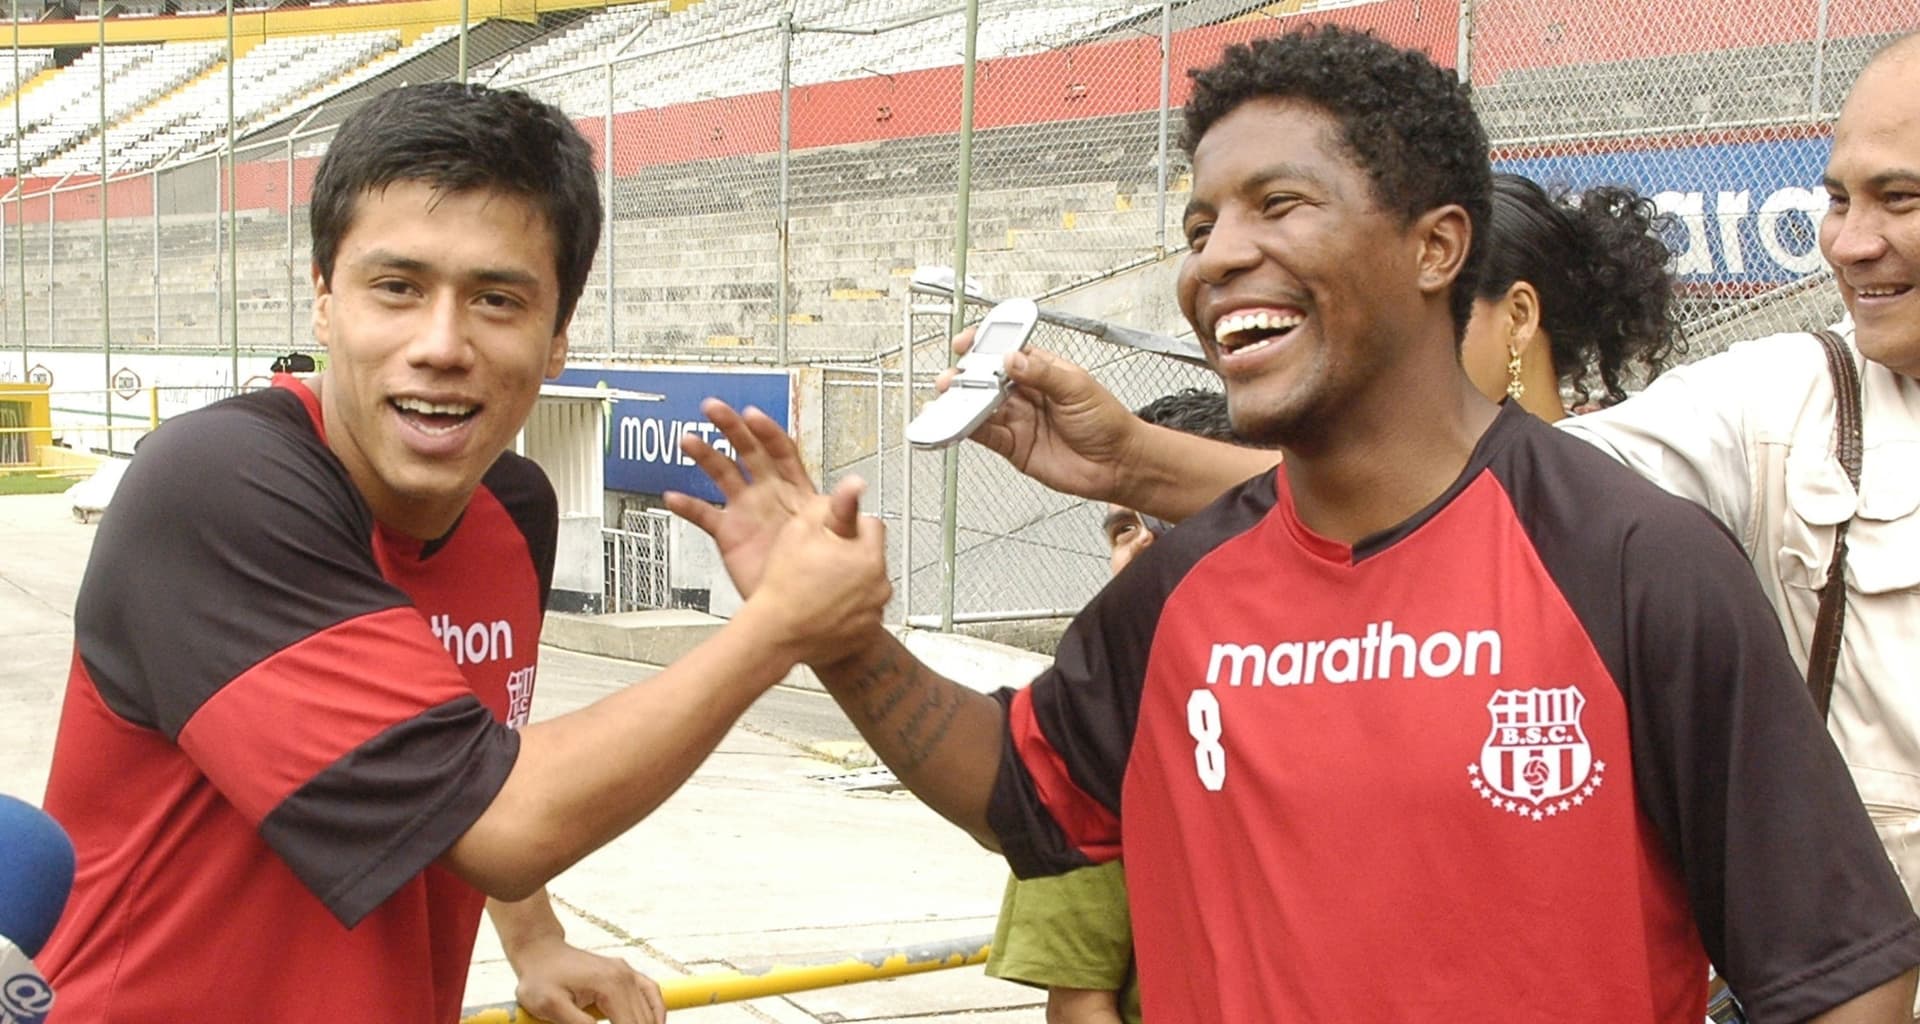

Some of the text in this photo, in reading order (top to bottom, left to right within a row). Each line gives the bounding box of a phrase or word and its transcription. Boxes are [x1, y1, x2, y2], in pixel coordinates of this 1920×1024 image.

[619, 416, 737, 467] movista
[1206, 621, 1502, 687] marathon
[1186, 688, 1226, 791] 8
[1501, 725, 1574, 745] B.S.C.
